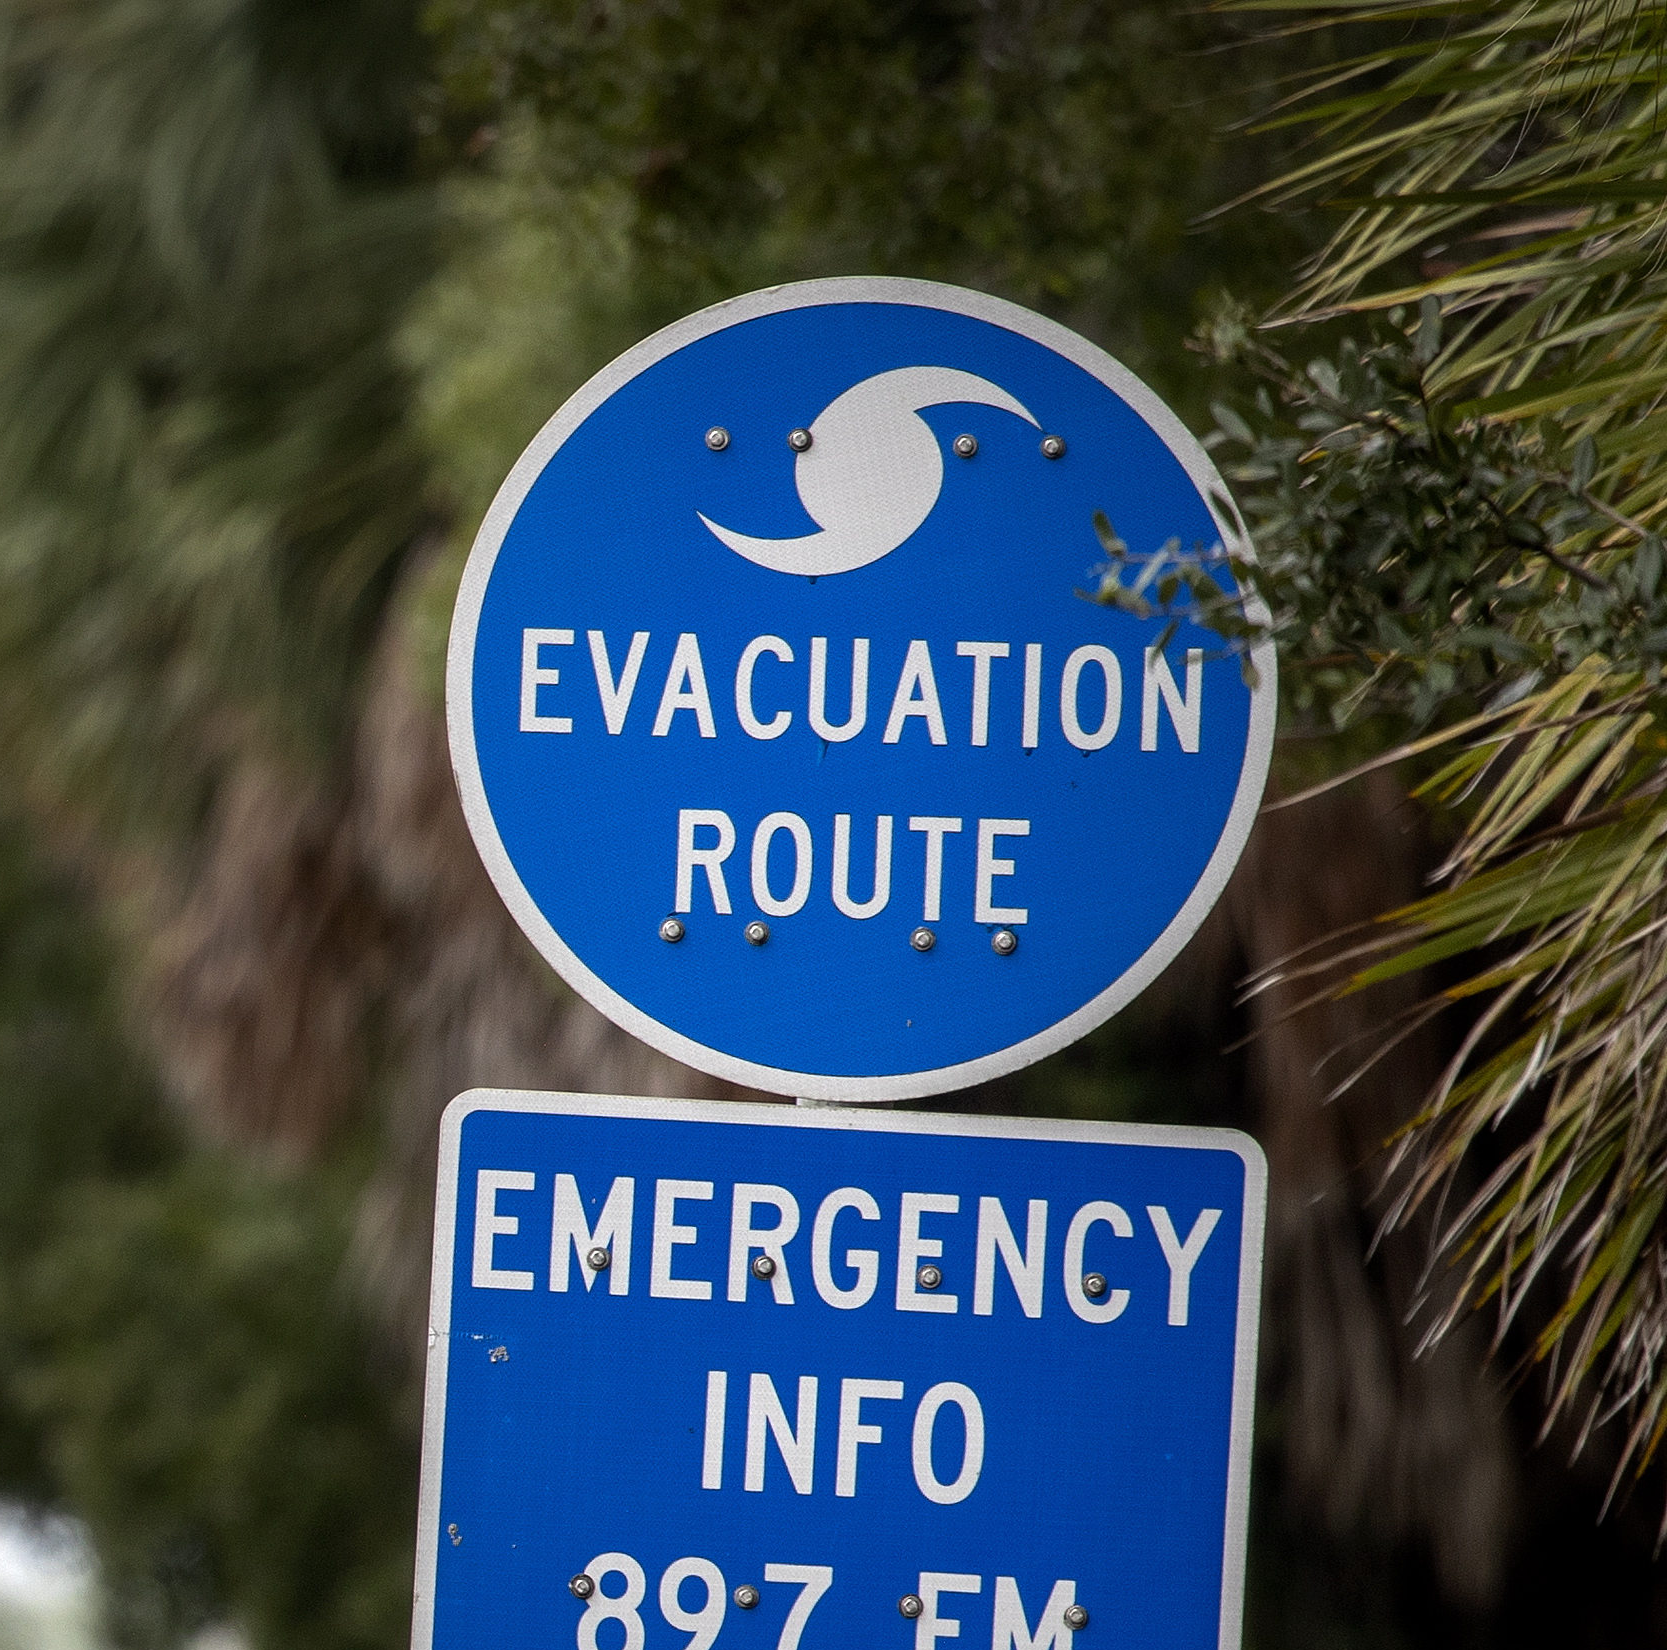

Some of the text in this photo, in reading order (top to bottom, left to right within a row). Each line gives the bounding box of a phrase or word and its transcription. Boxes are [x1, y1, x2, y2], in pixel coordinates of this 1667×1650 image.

[518, 627, 1204, 753] EVACUATION
[674, 808, 1031, 925] ROUTE
[470, 1169, 1222, 1327] EMERGENCY
[700, 1370, 986, 1505] INFO
